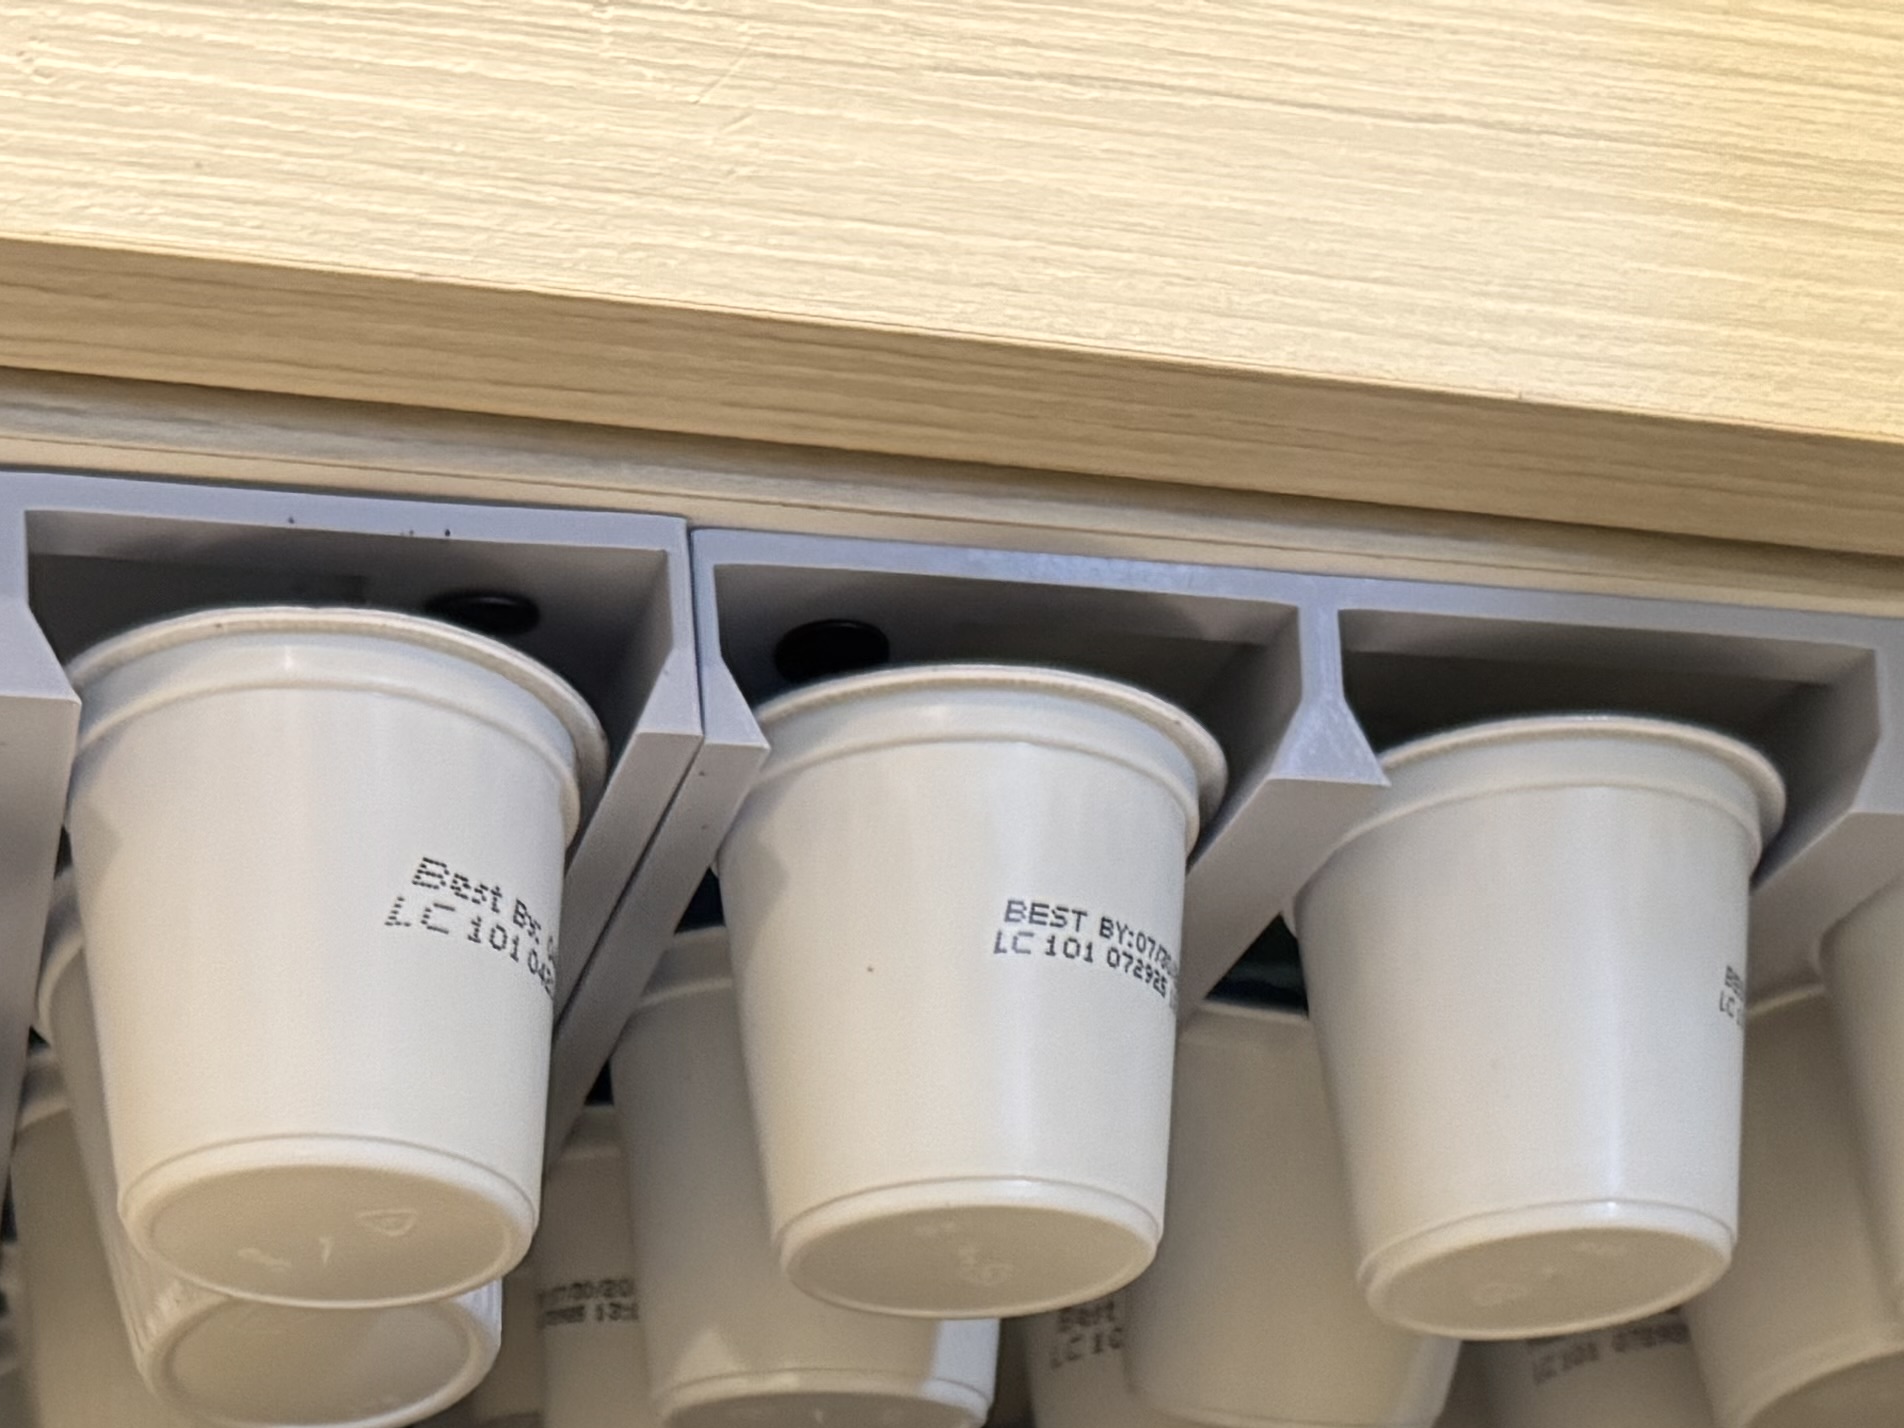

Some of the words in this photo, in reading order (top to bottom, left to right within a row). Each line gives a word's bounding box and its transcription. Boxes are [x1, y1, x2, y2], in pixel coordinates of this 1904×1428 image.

[412, 857, 503, 914] Best
[384, 896, 457, 935] LC
[467, 915, 520, 963] 101
[1003, 899, 1088, 932] BEST
[992, 930, 1036, 955] LC
[1045, 935, 1094, 964] 101
